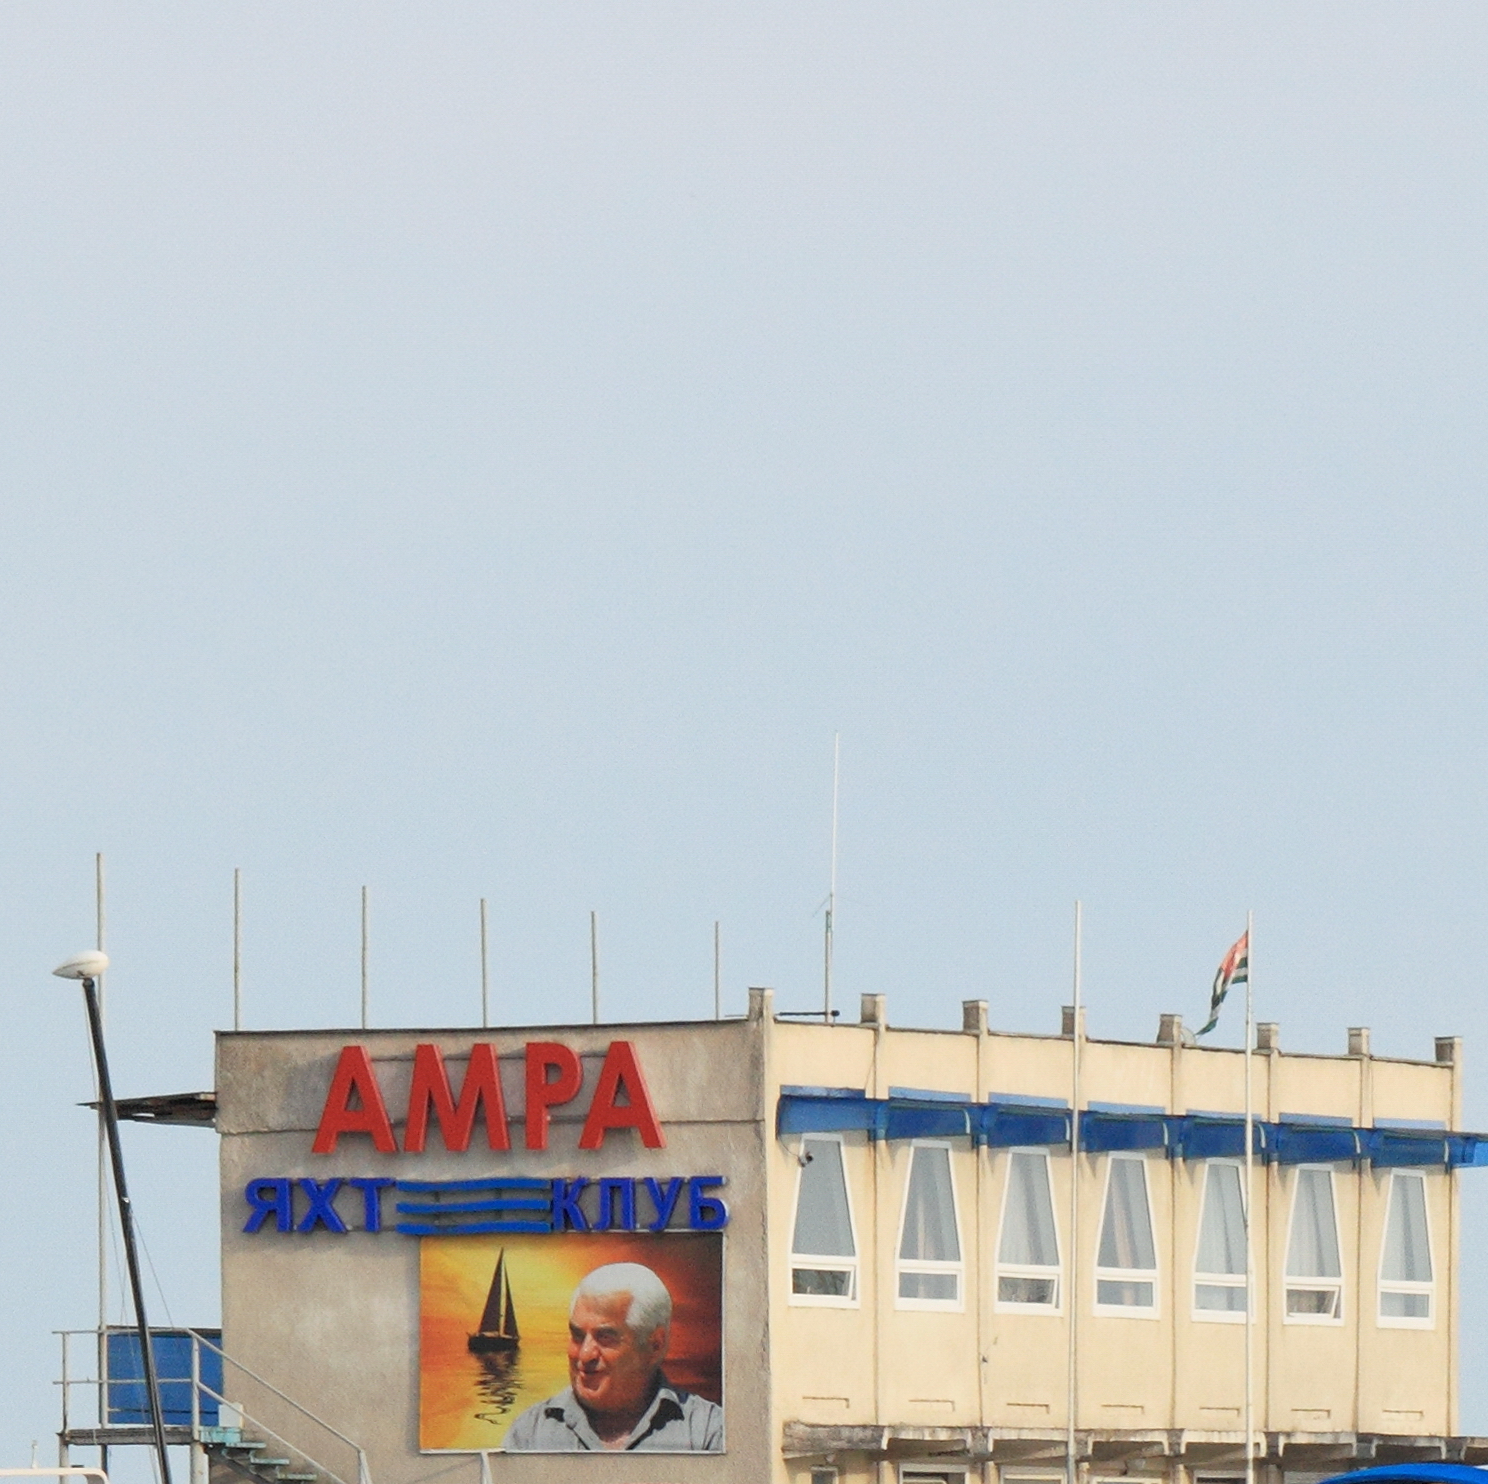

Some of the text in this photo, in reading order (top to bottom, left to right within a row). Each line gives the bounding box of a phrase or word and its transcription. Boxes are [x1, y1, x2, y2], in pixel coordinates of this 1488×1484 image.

[312, 1040, 667, 1153] АМРА
[242, 1175, 731, 1233] ЯХТ КЛУБ
